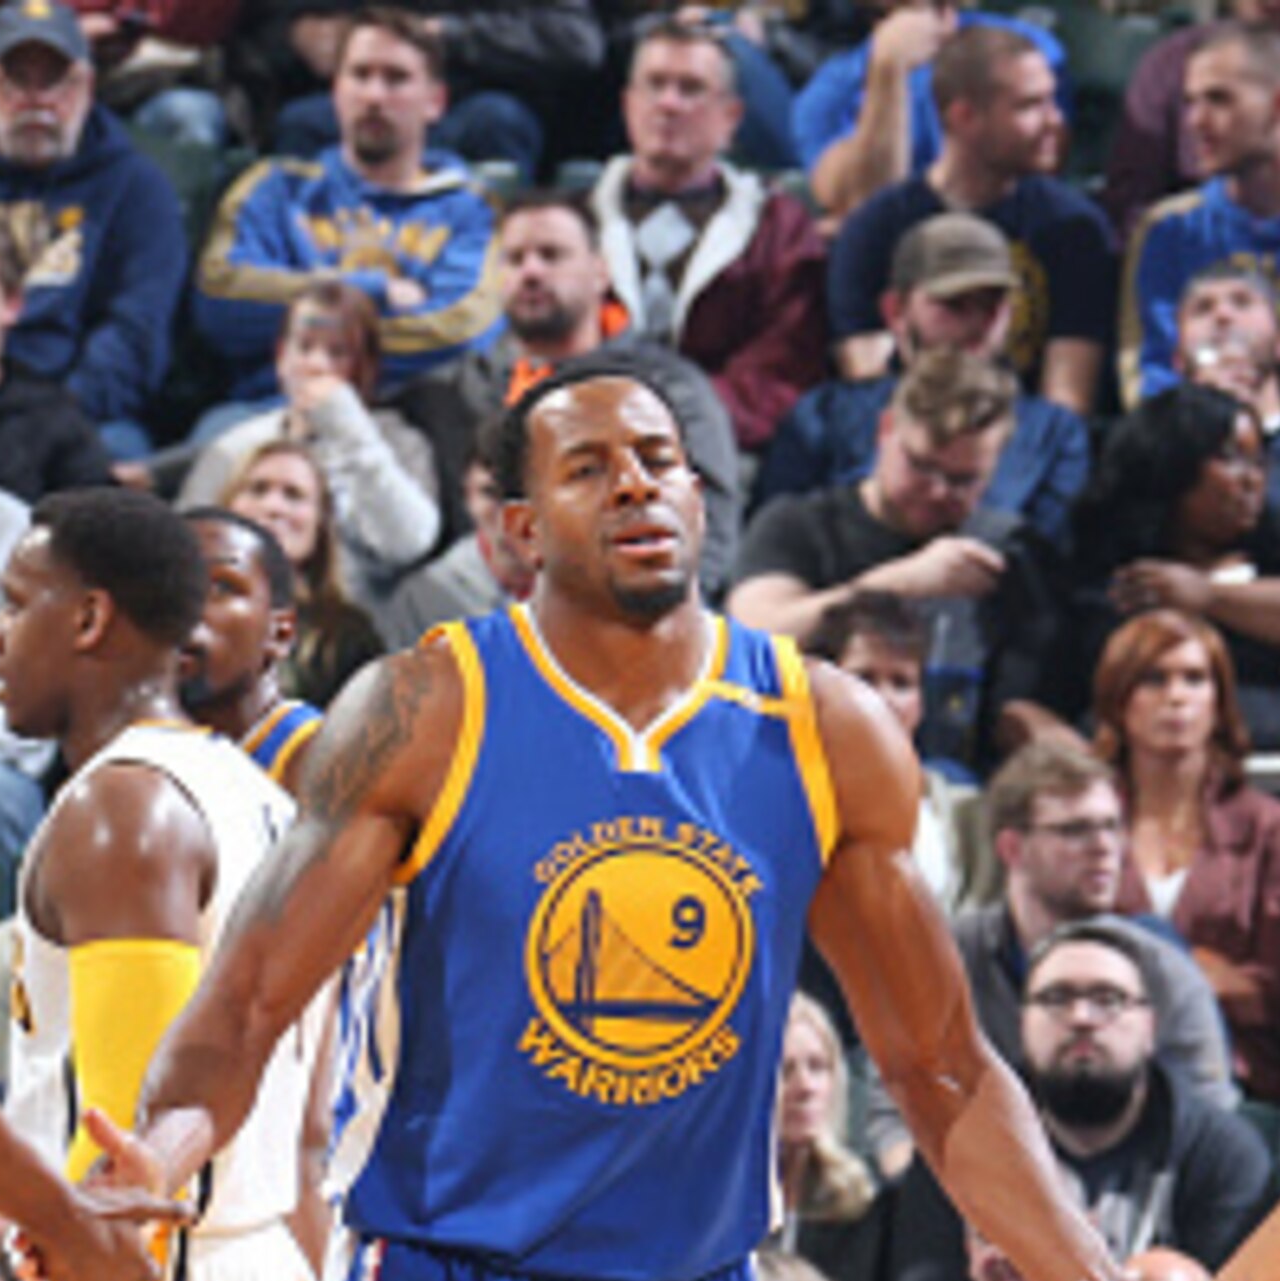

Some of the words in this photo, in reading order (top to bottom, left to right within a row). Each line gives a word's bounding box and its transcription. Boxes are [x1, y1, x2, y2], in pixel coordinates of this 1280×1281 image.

[534, 815, 665, 885] GOLDEN
[676, 820, 765, 898] STATE
[667, 894, 708, 950] 9
[517, 1015, 742, 1106] WARRIORS
